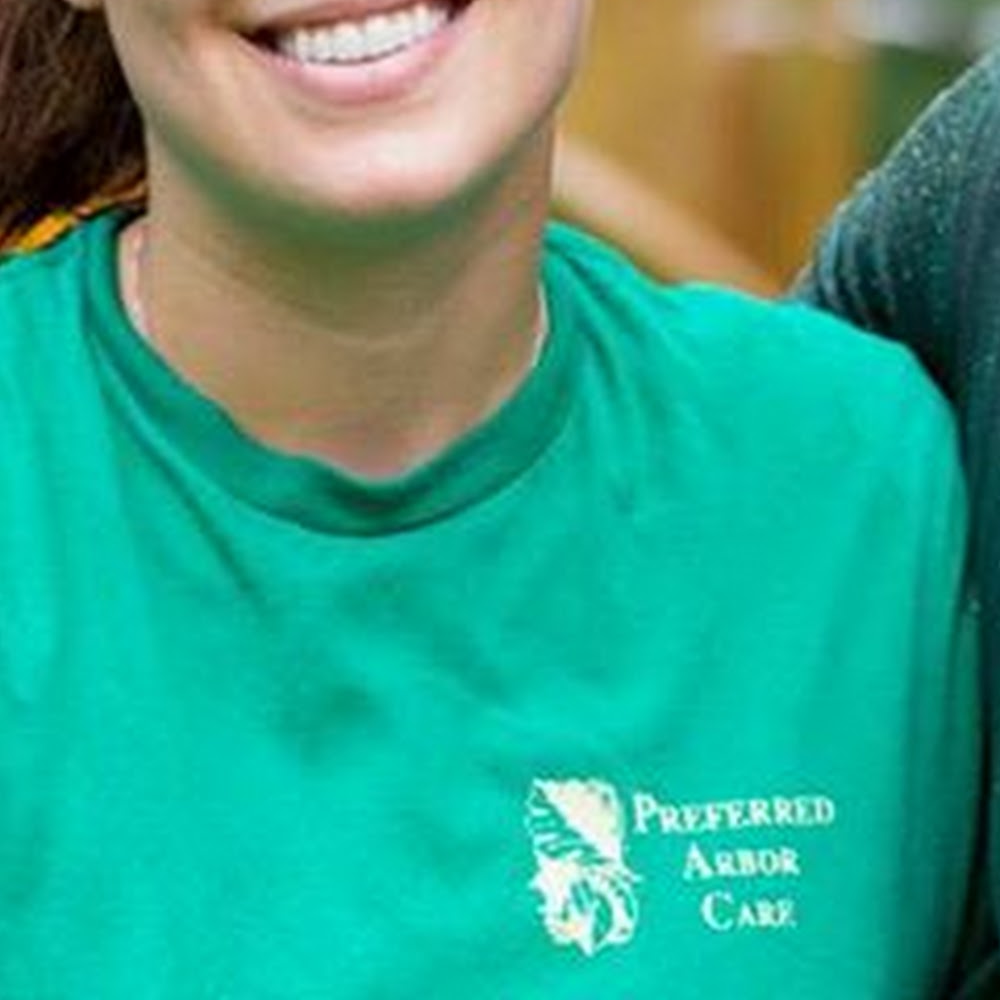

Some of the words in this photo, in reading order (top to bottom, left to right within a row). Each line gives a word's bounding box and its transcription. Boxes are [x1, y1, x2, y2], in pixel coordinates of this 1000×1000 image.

[632, 792, 835, 834] PREFERRED
[682, 841, 800, 880] ARBOR
[700, 890, 797, 931] CARE
